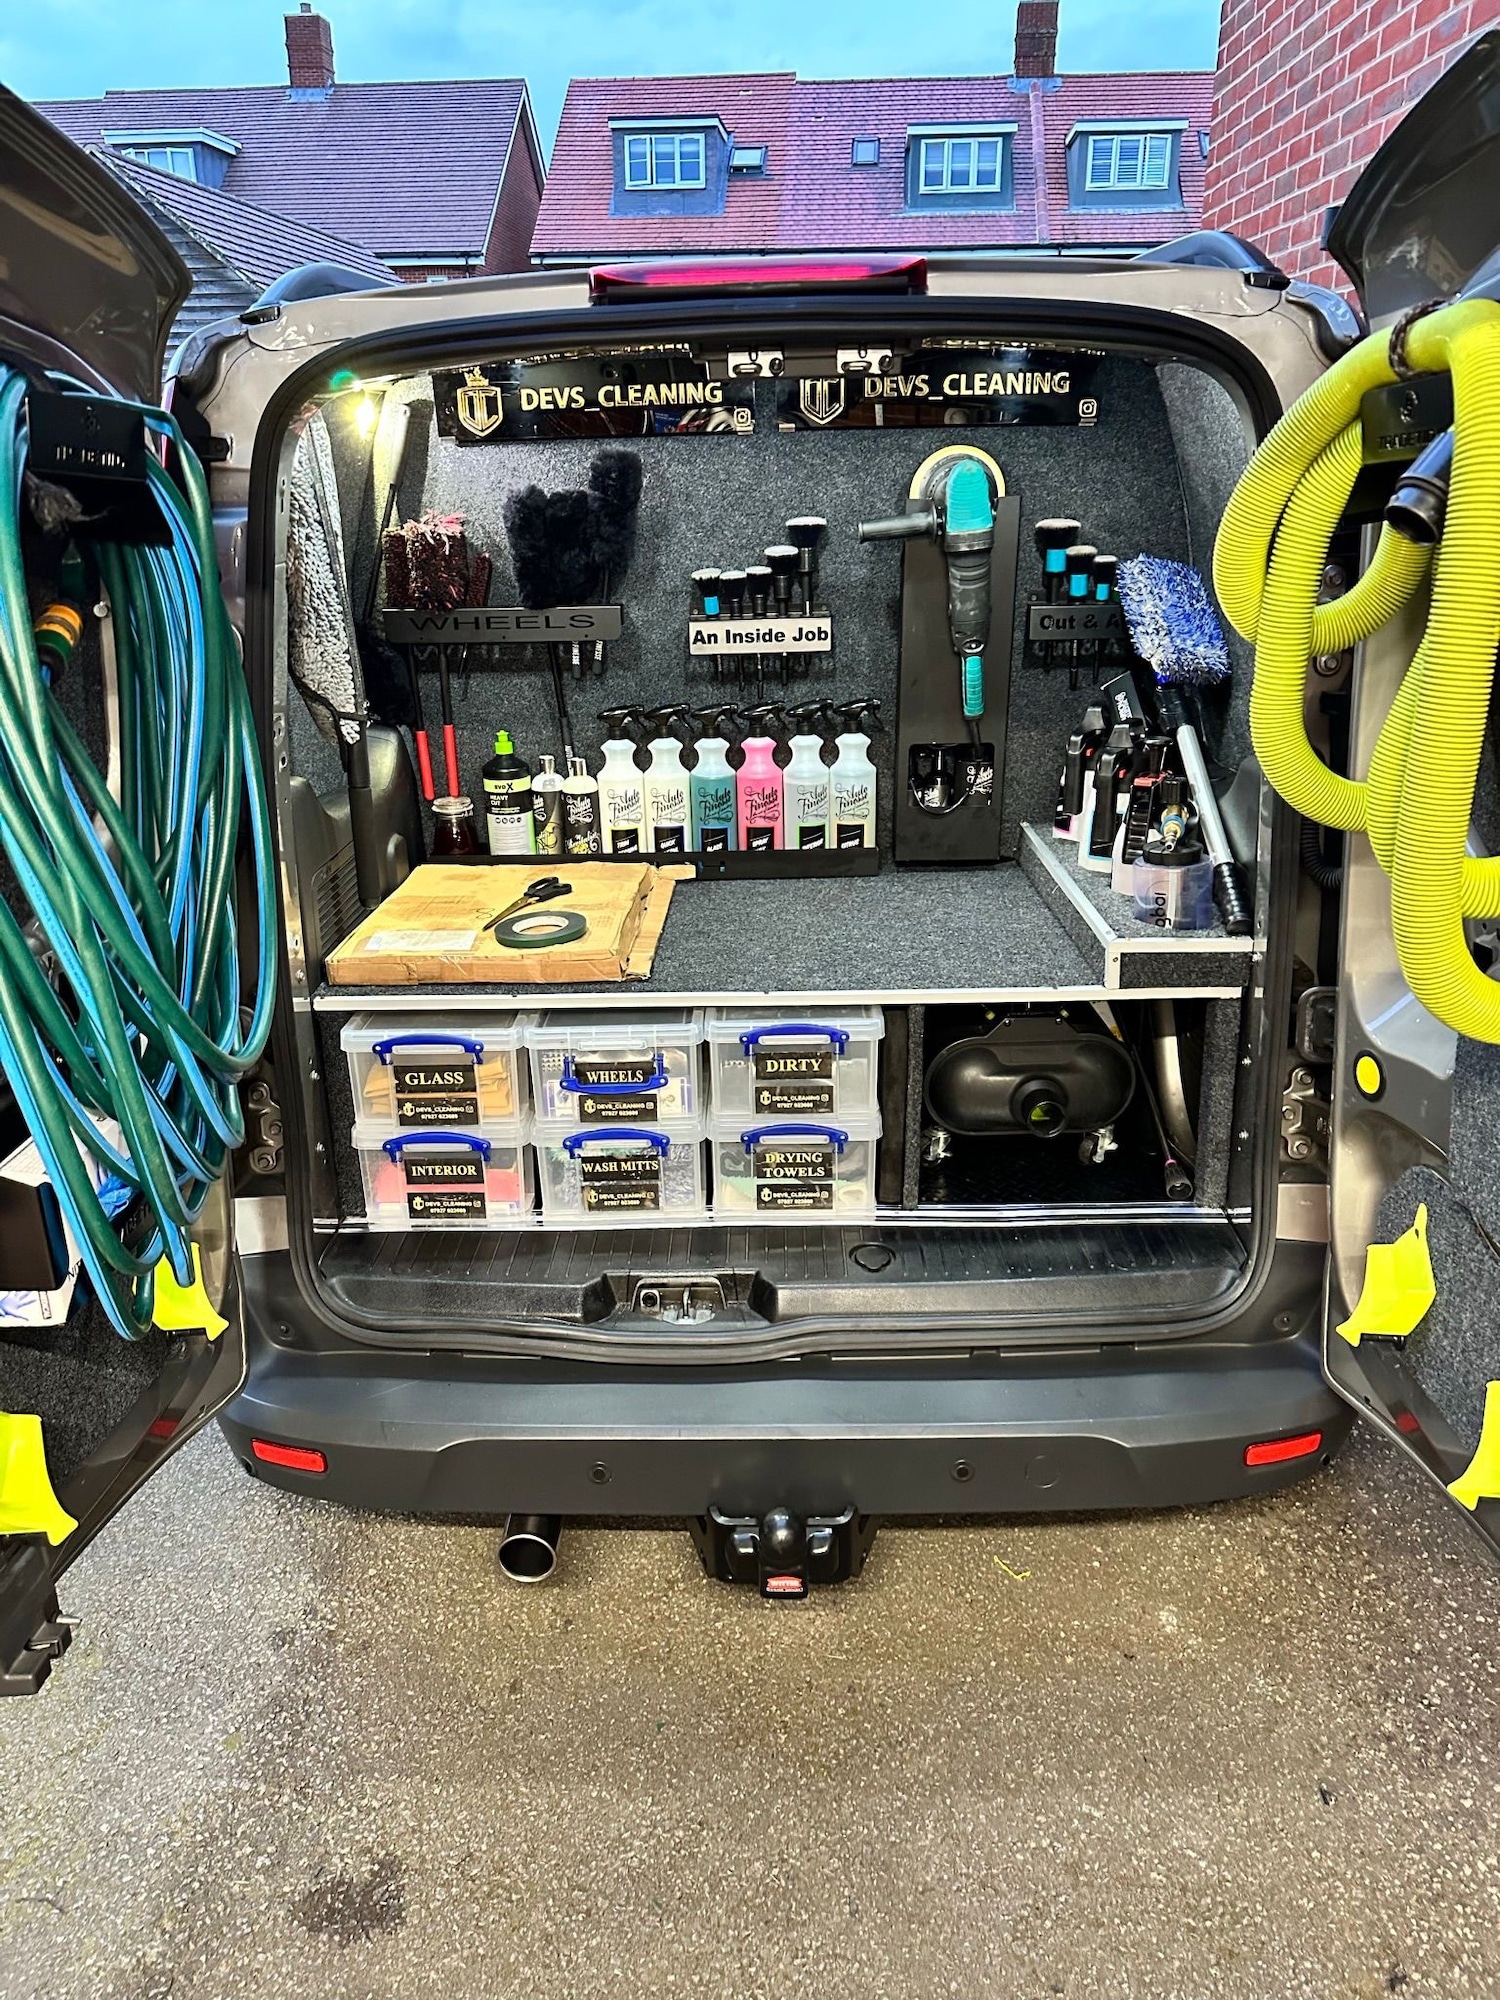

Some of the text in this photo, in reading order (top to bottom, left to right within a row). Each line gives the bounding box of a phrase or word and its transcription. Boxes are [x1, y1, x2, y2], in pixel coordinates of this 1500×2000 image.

[520, 381, 723, 412] DEVS_CLEANING
[409, 614, 595, 631] WHEELS
[1040, 614, 1076, 630] Out
[1083, 614, 1098, 630] &
[692, 627, 829, 645] An Inside Job
[766, 1058, 822, 1073] DIRTY
[404, 1071, 464, 1086] GLASS
[586, 1070, 644, 1083] WHEELS
[764, 1152, 823, 1164] DRYING
[411, 1164, 477, 1177] INTERIOR
[582, 1160, 659, 1173] WASH MITTS
[763, 1166, 825, 1177] TOWELS
